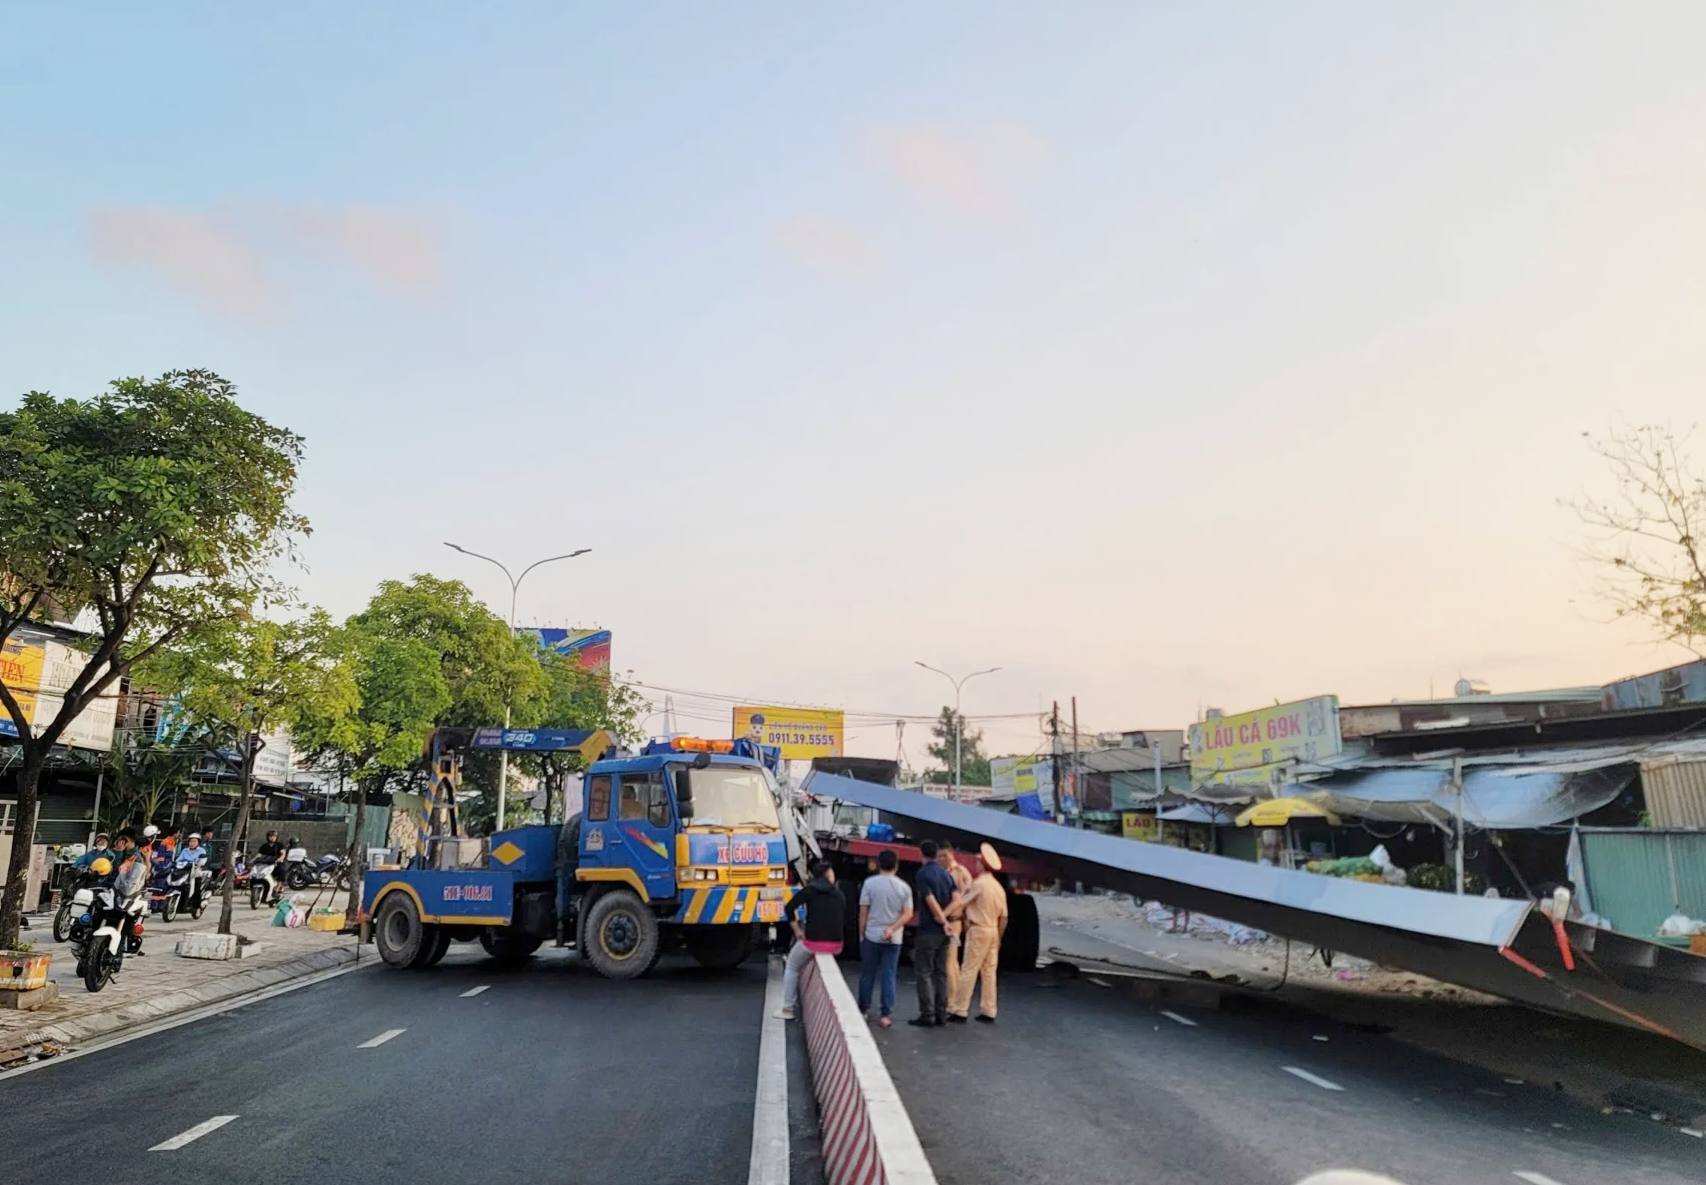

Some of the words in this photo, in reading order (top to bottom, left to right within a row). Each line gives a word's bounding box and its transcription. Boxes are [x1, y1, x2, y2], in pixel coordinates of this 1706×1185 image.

[768, 732, 835, 745] 0911.39.5555
[1239, 719, 1261, 744] CÁ
[1267, 713, 1302, 740] 69K
